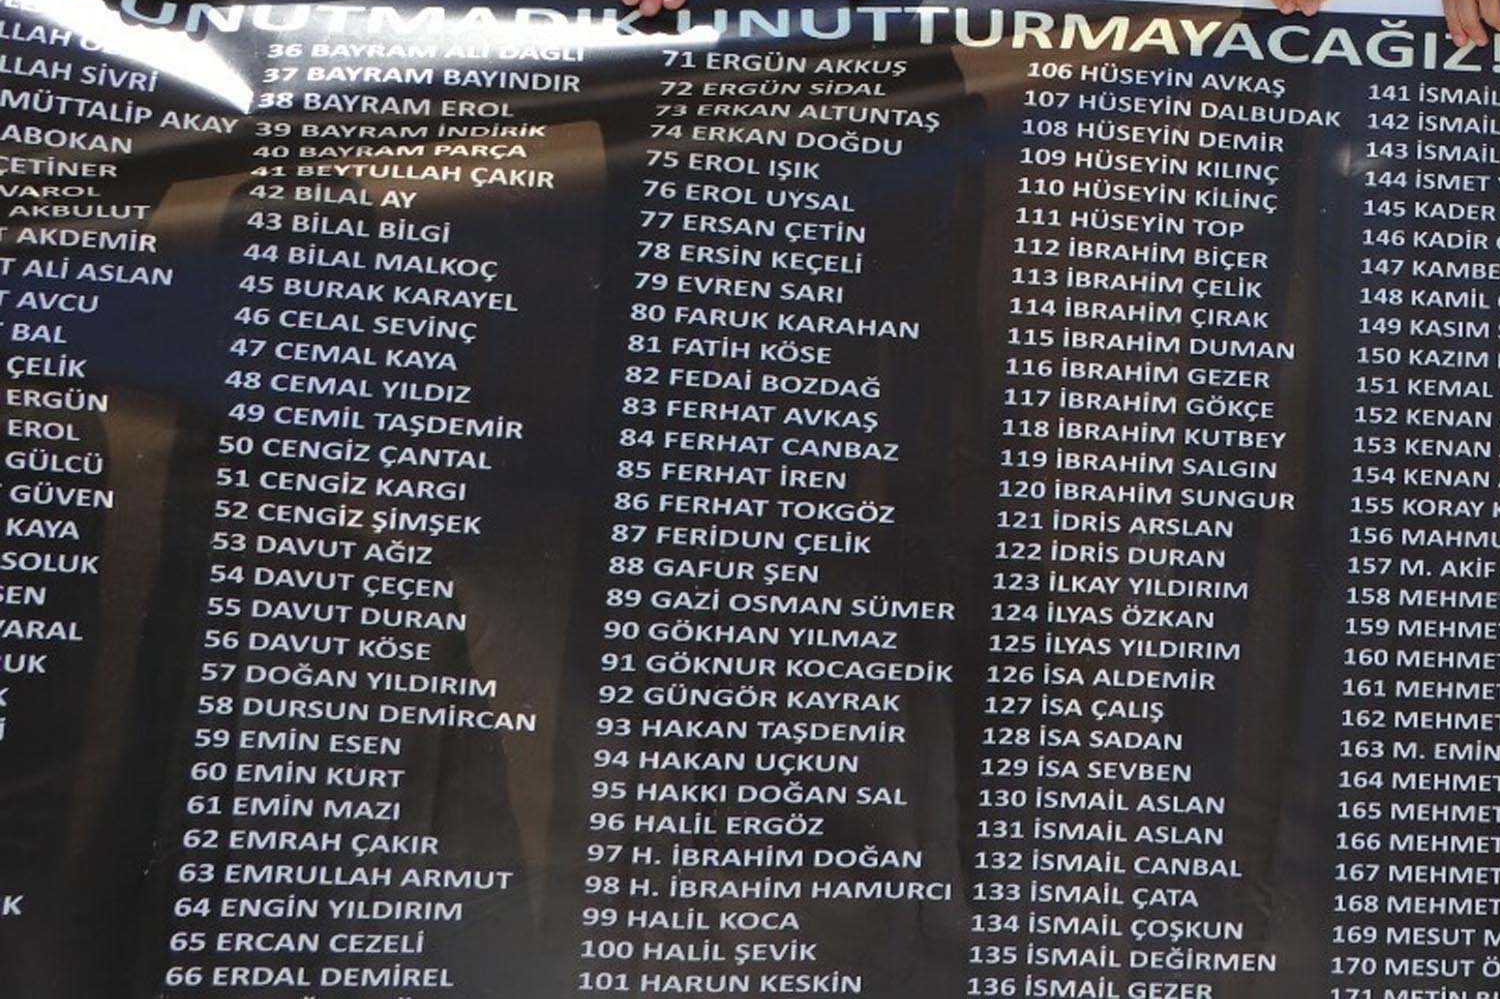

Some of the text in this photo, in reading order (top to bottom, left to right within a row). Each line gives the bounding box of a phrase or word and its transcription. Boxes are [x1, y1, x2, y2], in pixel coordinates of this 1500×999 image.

[662, 49, 906, 76] 71 ERGÜN AKKUŞ
[1028, 63, 1285, 98] 106 HÜSEYİN AVKAŞ
[258, 89, 512, 116] 38 BAYRAM EROL
[1369, 85, 1410, 101] 141
[1420, 83, 1500, 106] İSMAİL
[0, 89, 238, 133] MÜTTALİP AKAY
[247, 212, 450, 242] 43 BİLAL BİLGİ
[641, 211, 865, 243] 77 ERSAN ÇETİN
[1015, 238, 1267, 270] 112 İBRAHİM BİÇER
[1362, 259, 1404, 275] 147
[7, 356, 86, 378] ÇELİK
[626, 366, 880, 397] 82 FEDAİ BOZDAĞ
[229, 404, 522, 439] 49 CEMİL TAŞDEMİR
[1003, 418, 1286, 448] 118 İBRAHİM KUTBEY
[6, 452, 102, 474] GÜLCÜ
[609, 557, 818, 585] 88 GAFUR ŞEN
[208, 598, 466, 630] 55 DAVUT DURAN
[992, 602, 1213, 628] 124 İLYAS ÖZKAN
[1346, 618, 1389, 635] 159
[191, 763, 404, 787] 60 EMİN KURT
[594, 750, 858, 775] 94 HAKAN UÇKUN
[982, 759, 1191, 782] 129 İSA SEVBEN
[1340, 771, 1383, 788] 164
[1333, 926, 1376, 943] 169
[1387, 928, 1475, 945] MESUT
[582, 940, 816, 965] 100 HALİL ŞEVİK
[970, 946, 1275, 971] 135 İSMAİL DEĞİRMEN
